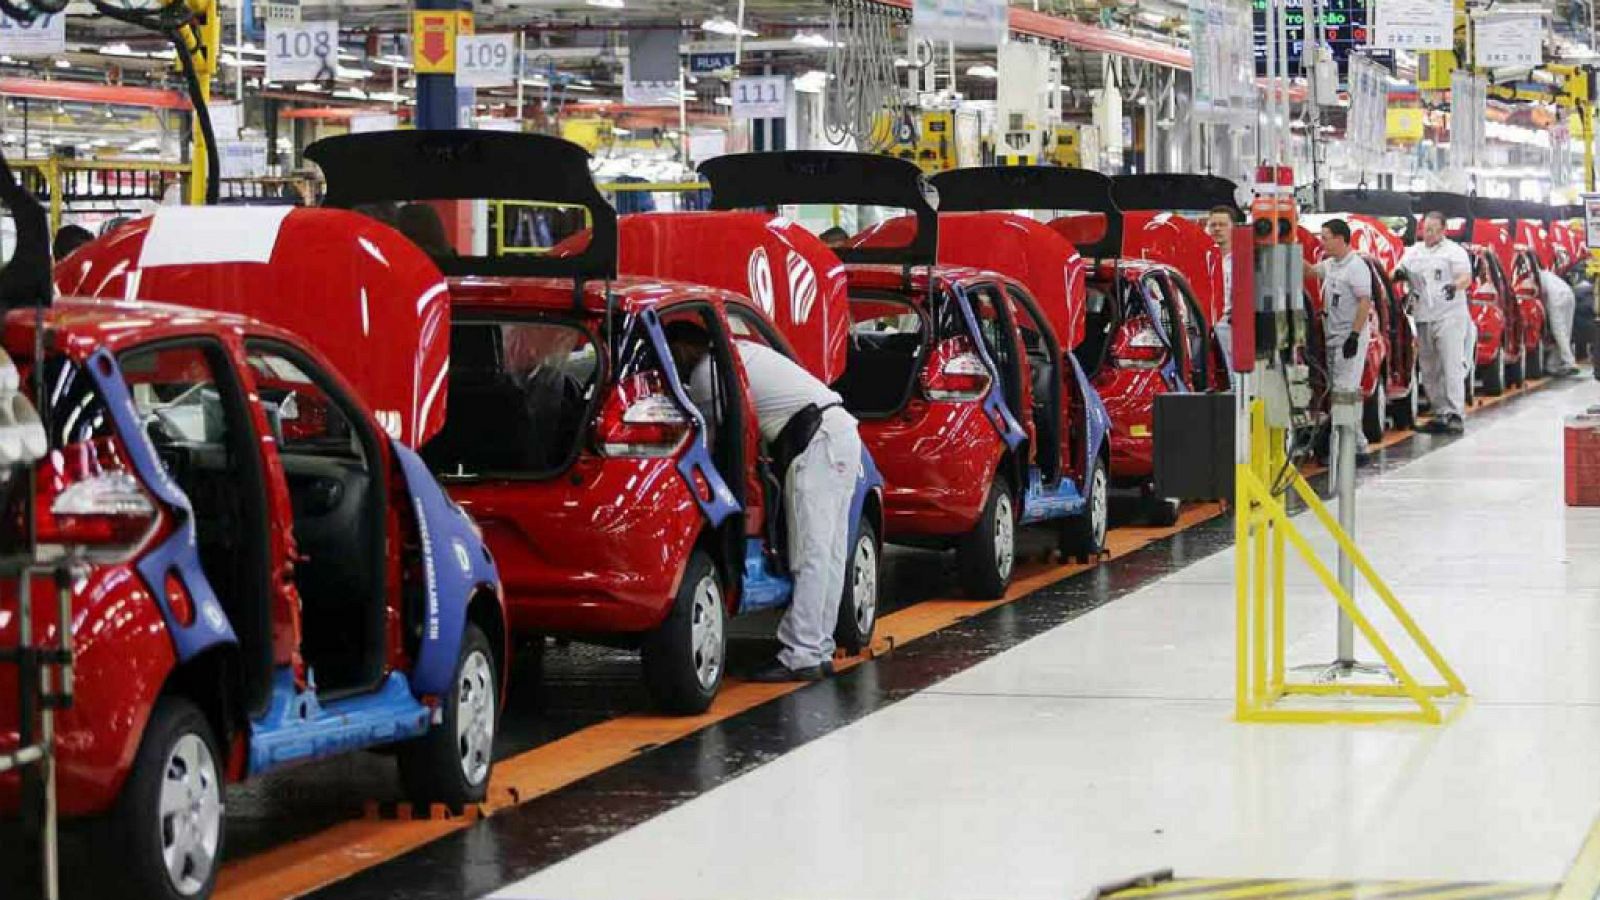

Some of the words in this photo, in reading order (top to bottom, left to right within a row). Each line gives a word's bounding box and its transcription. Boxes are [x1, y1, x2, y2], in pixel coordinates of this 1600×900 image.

[276, 31, 331, 58] 108
[464, 43, 507, 67] 109
[739, 84, 779, 103] 111
